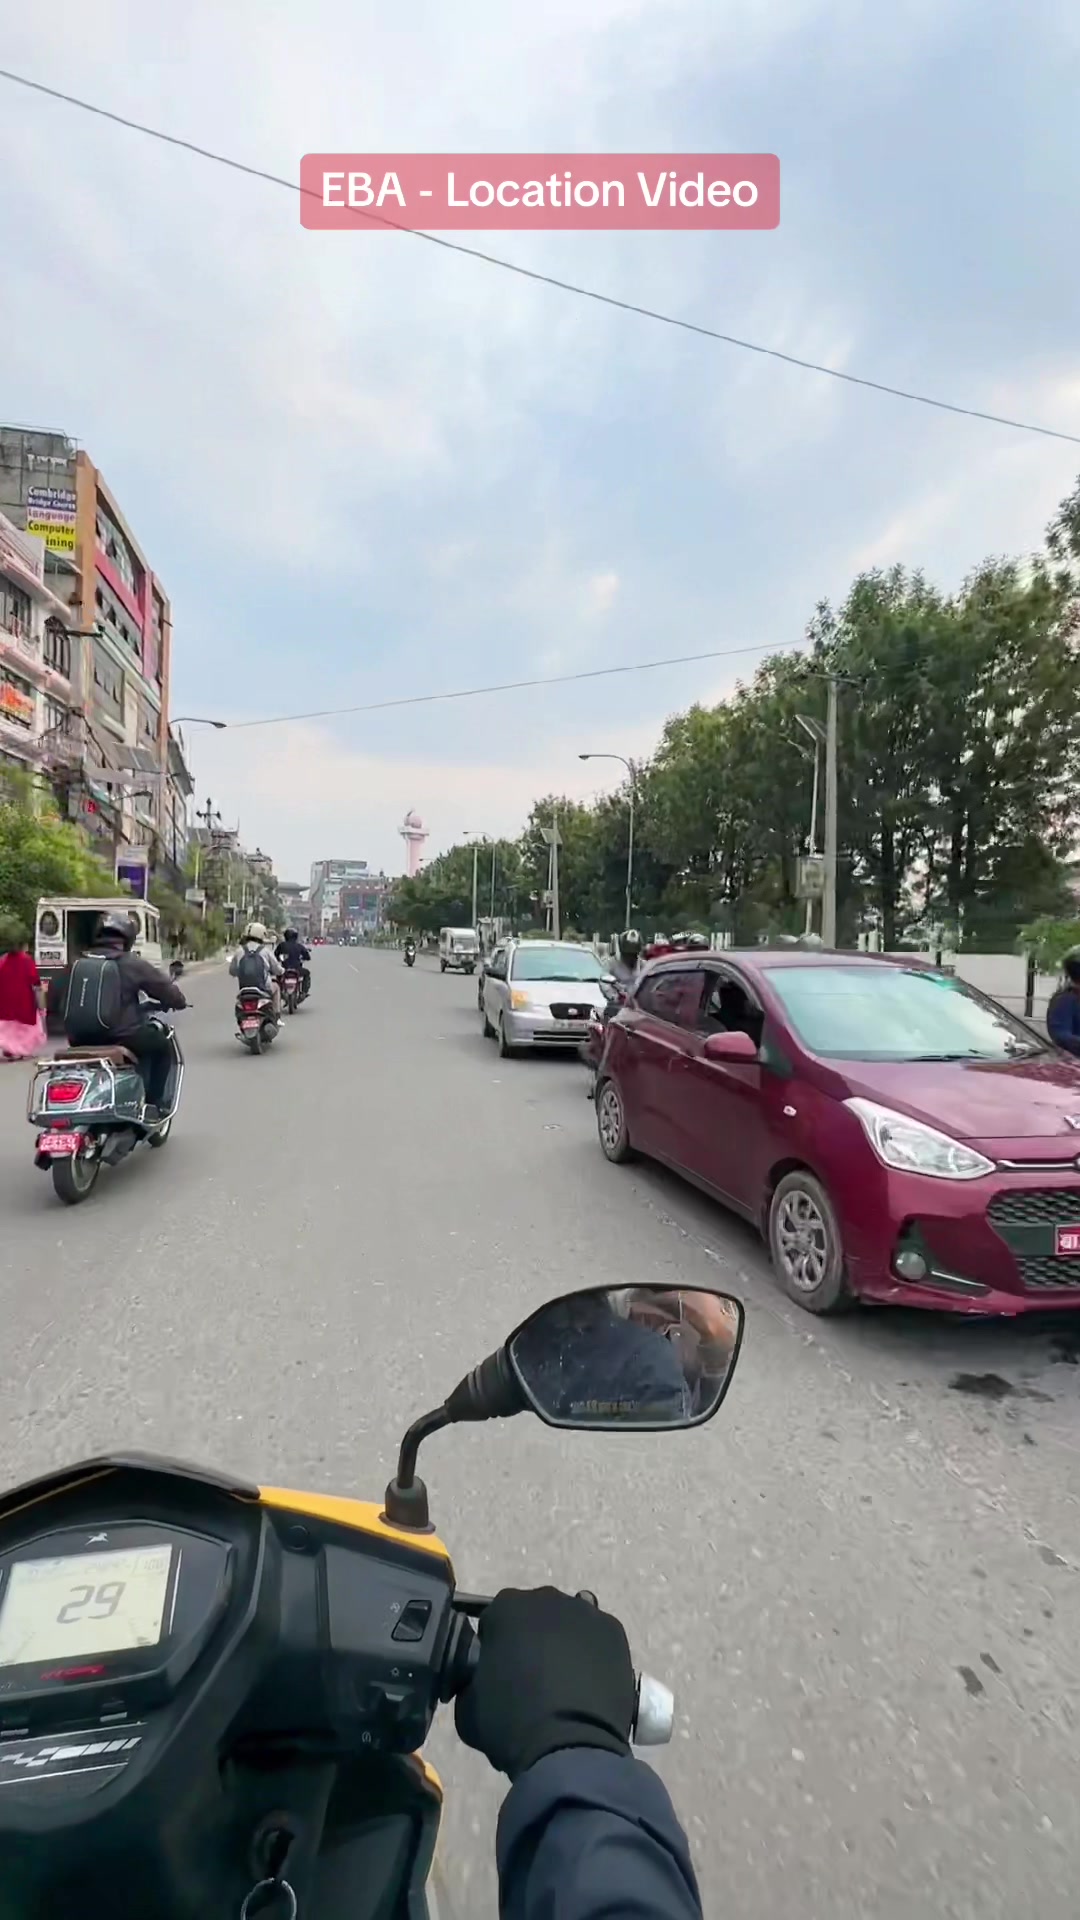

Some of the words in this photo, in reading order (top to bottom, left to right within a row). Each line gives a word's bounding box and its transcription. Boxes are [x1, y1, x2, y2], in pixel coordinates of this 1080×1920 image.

[28, 508, 75, 523] Language
[28, 520, 75, 535] Computer
[45, 535, 74, 551] ining
[56, 1581, 127, 1624] 29
